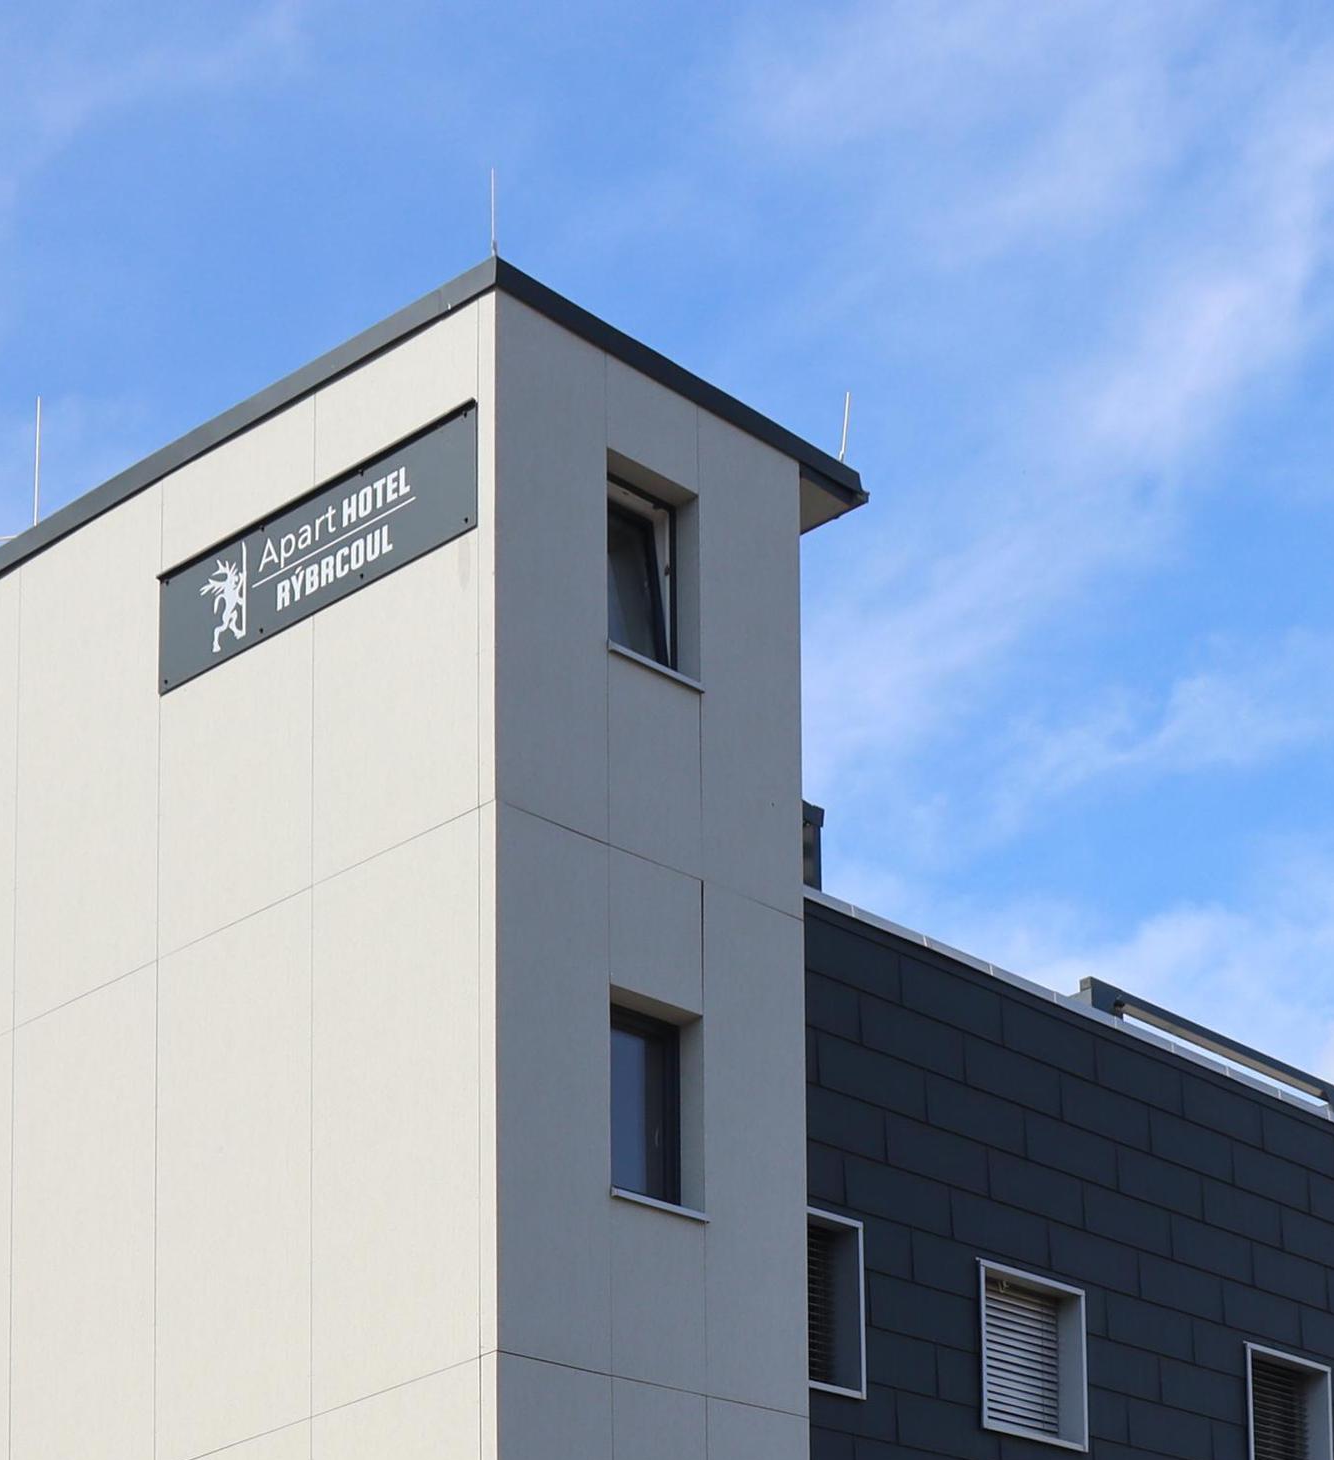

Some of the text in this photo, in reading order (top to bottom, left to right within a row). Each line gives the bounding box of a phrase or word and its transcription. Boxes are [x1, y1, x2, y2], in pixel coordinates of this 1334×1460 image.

[258, 466, 411, 573] Apart HOTEL
[276, 524, 393, 612] RÝBRCOUL
